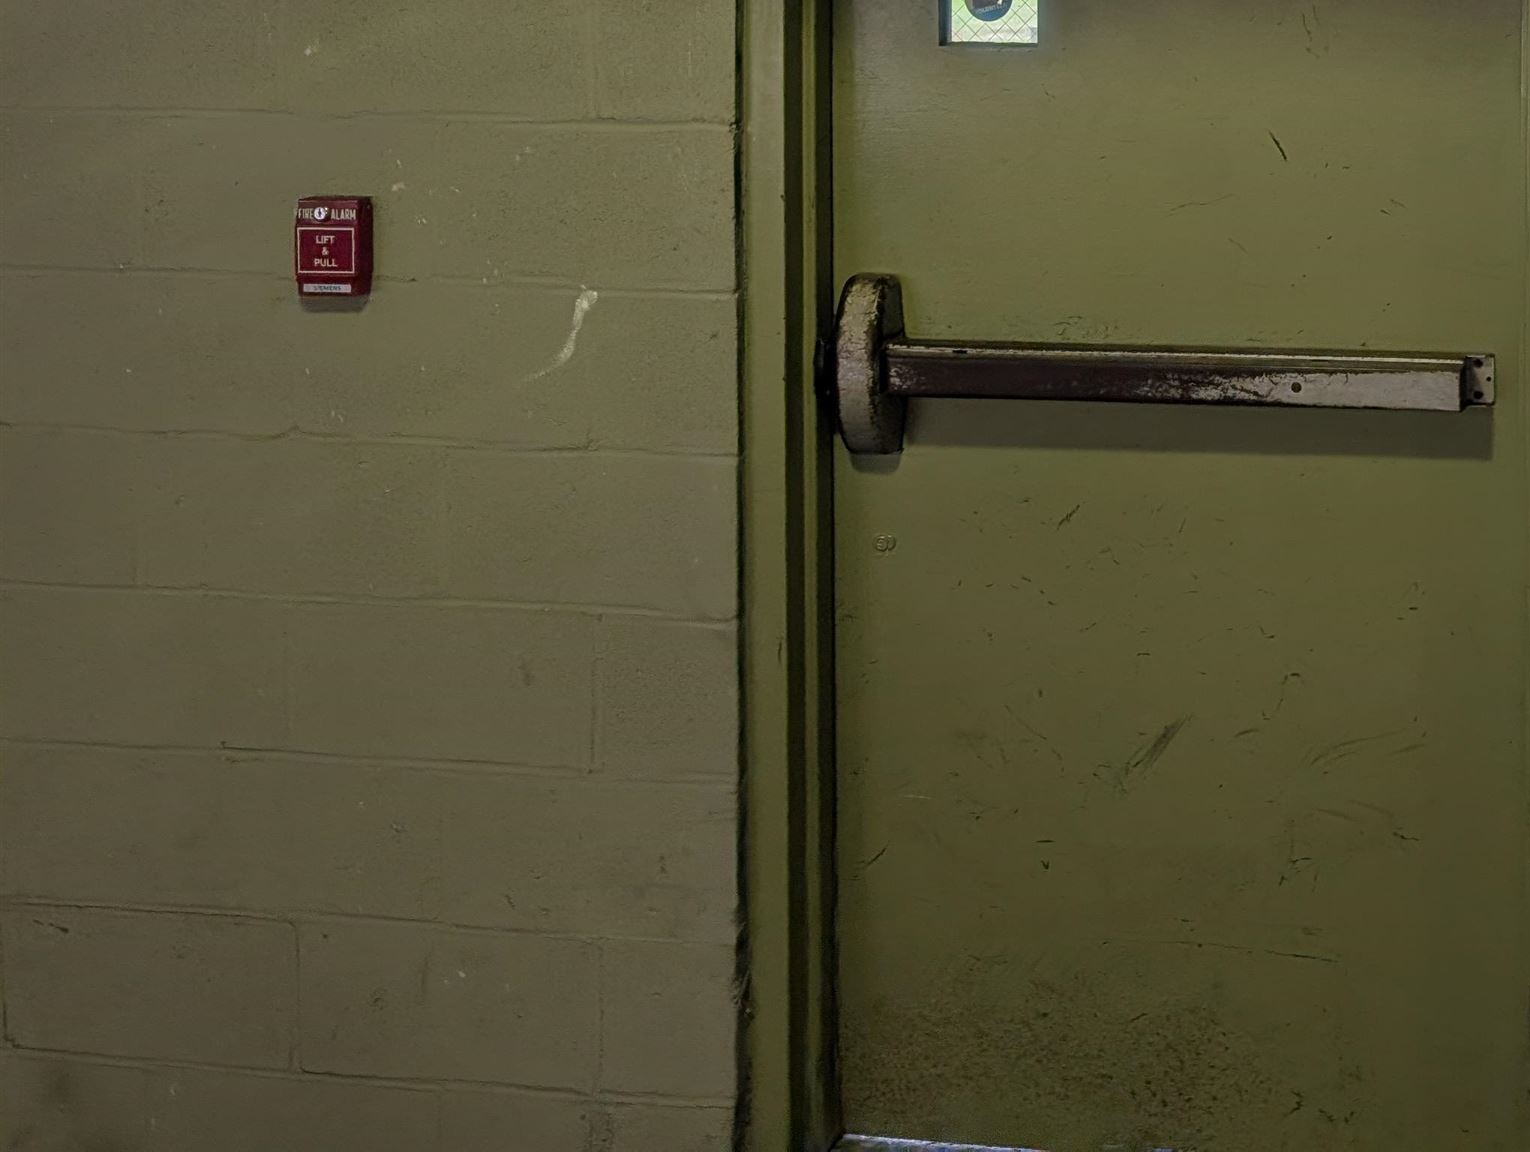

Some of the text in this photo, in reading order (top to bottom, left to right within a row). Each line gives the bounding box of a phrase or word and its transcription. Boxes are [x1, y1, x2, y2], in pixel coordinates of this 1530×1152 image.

[298, 208, 356, 220] FIRE ALARM
[315, 235, 335, 245] LIFT
[321, 246, 329, 256] &
[313, 258, 338, 267] PULL
